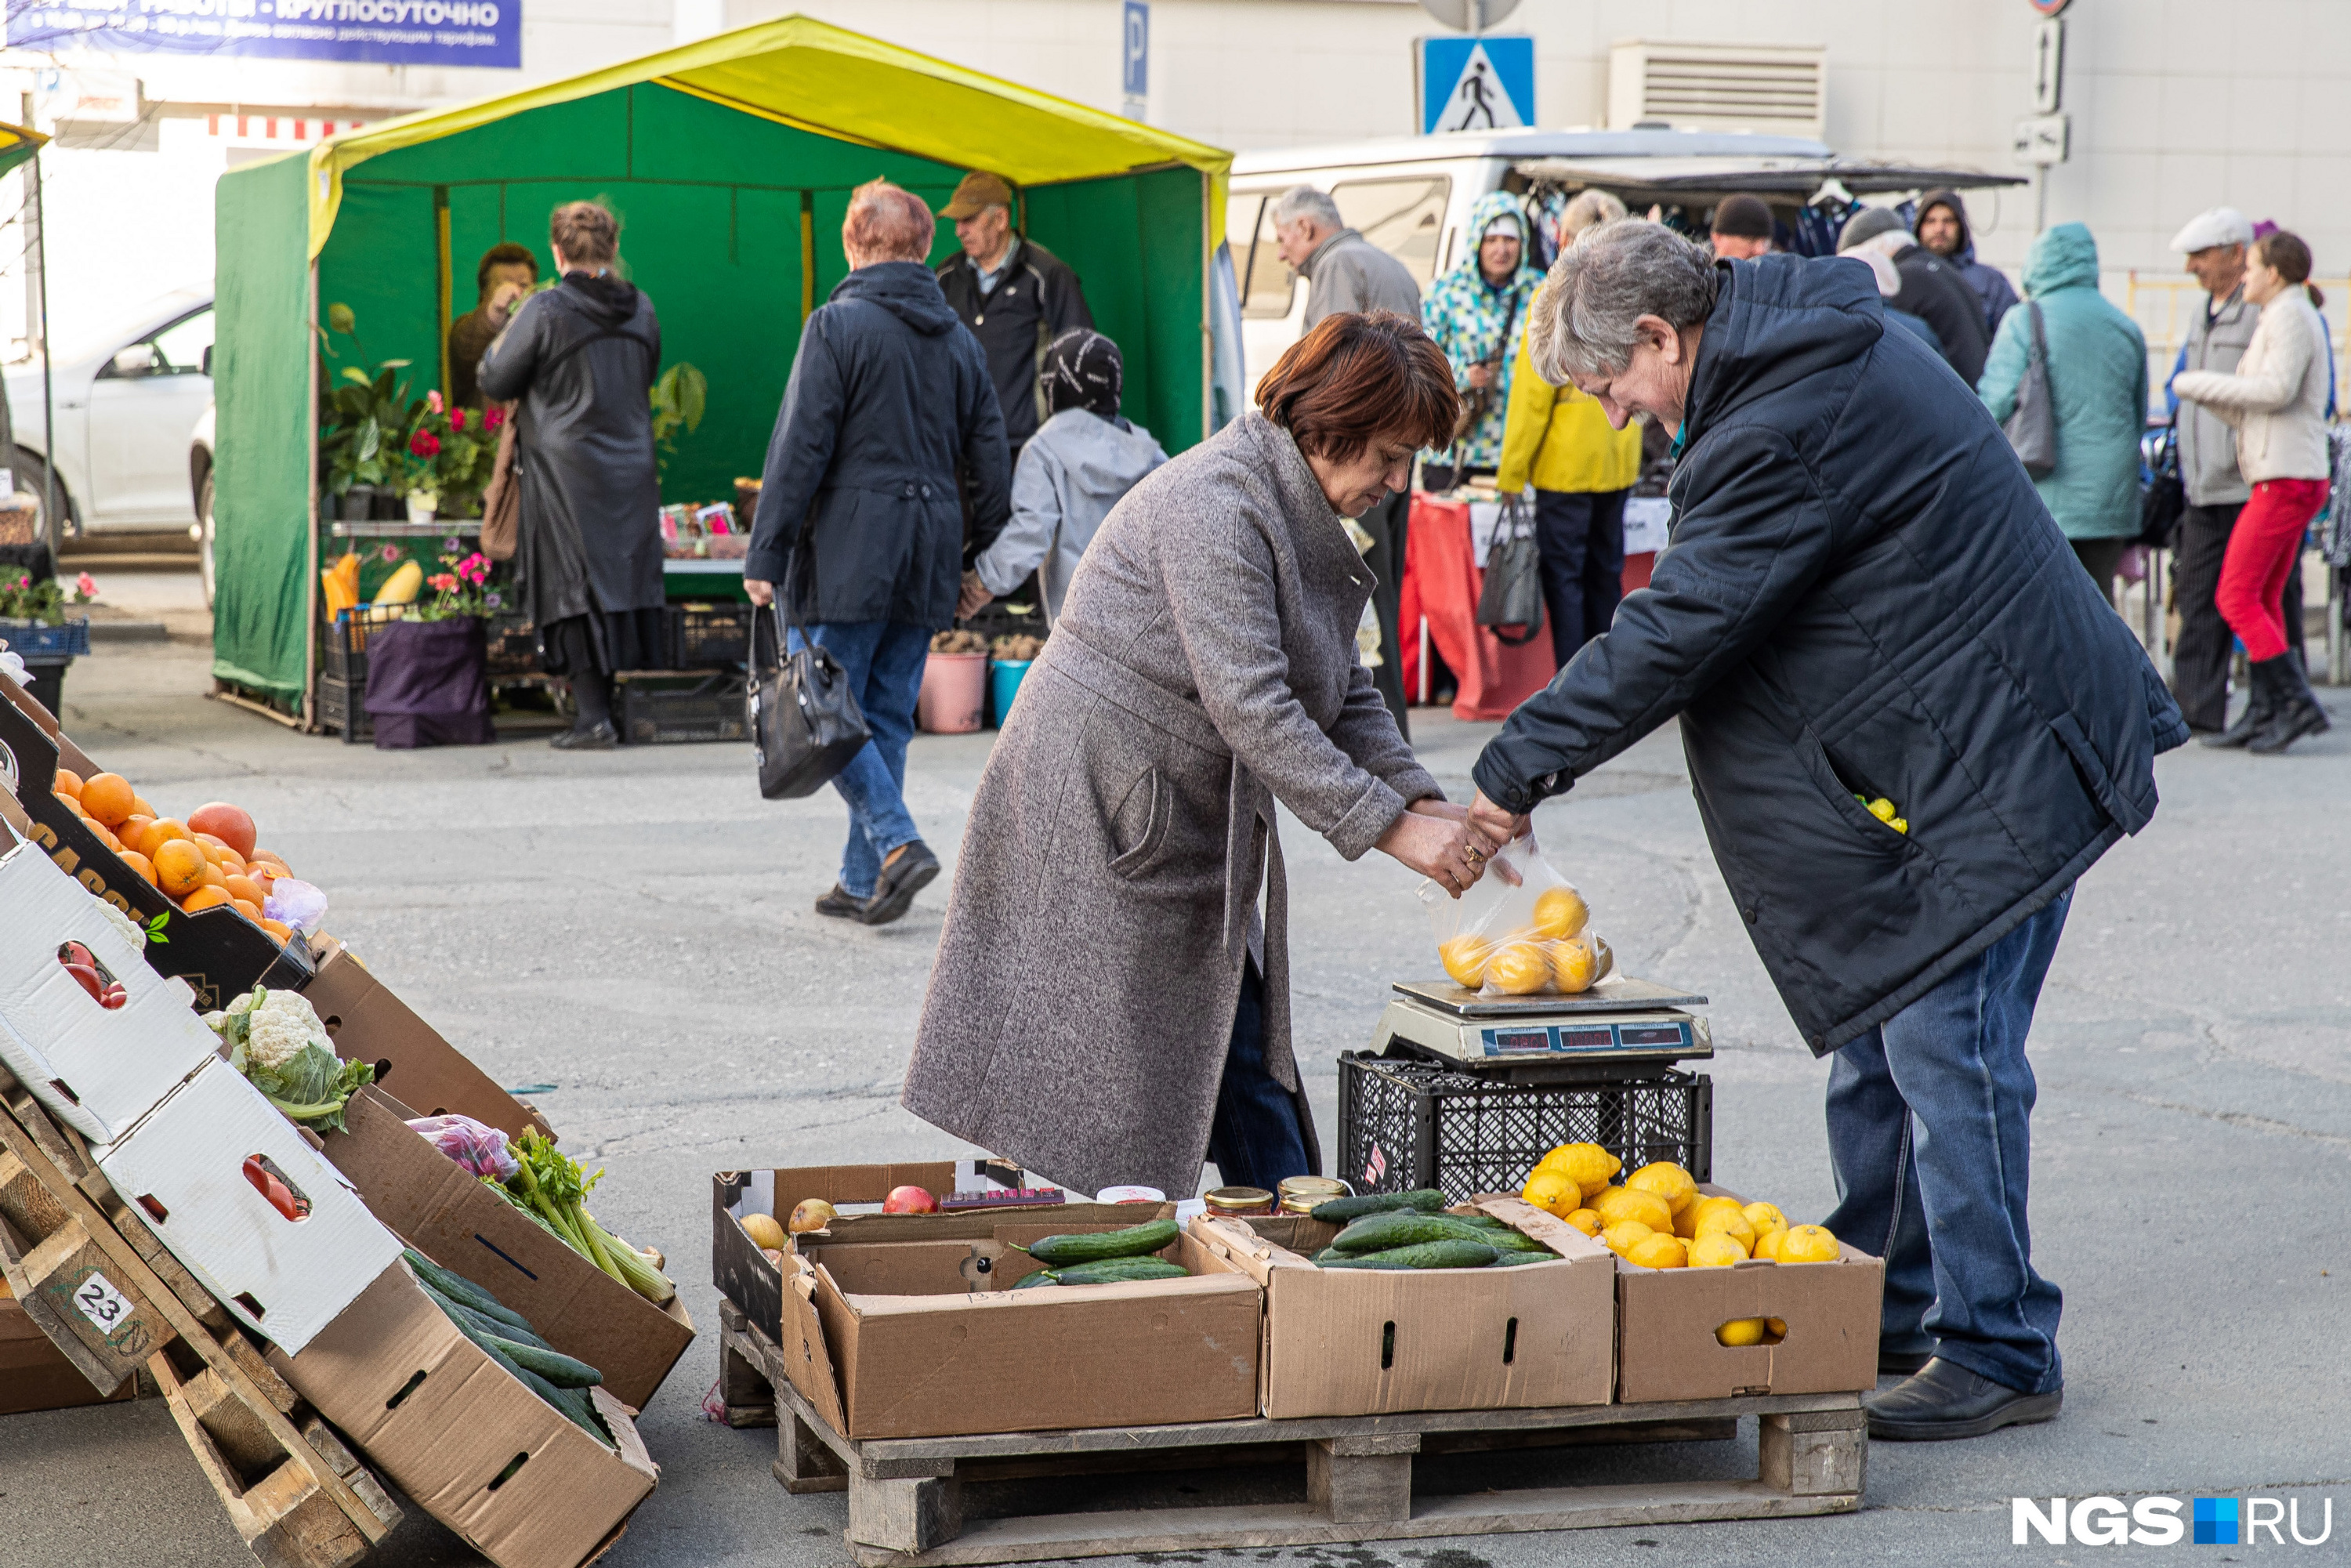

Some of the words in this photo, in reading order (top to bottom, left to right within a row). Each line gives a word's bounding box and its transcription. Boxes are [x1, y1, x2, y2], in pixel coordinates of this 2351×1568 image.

[277, 0, 499, 27] КРУГЛОСУТОЧНО
[1128, 9, 1144, 85] P
[79, 1284, 121, 1321] 23
